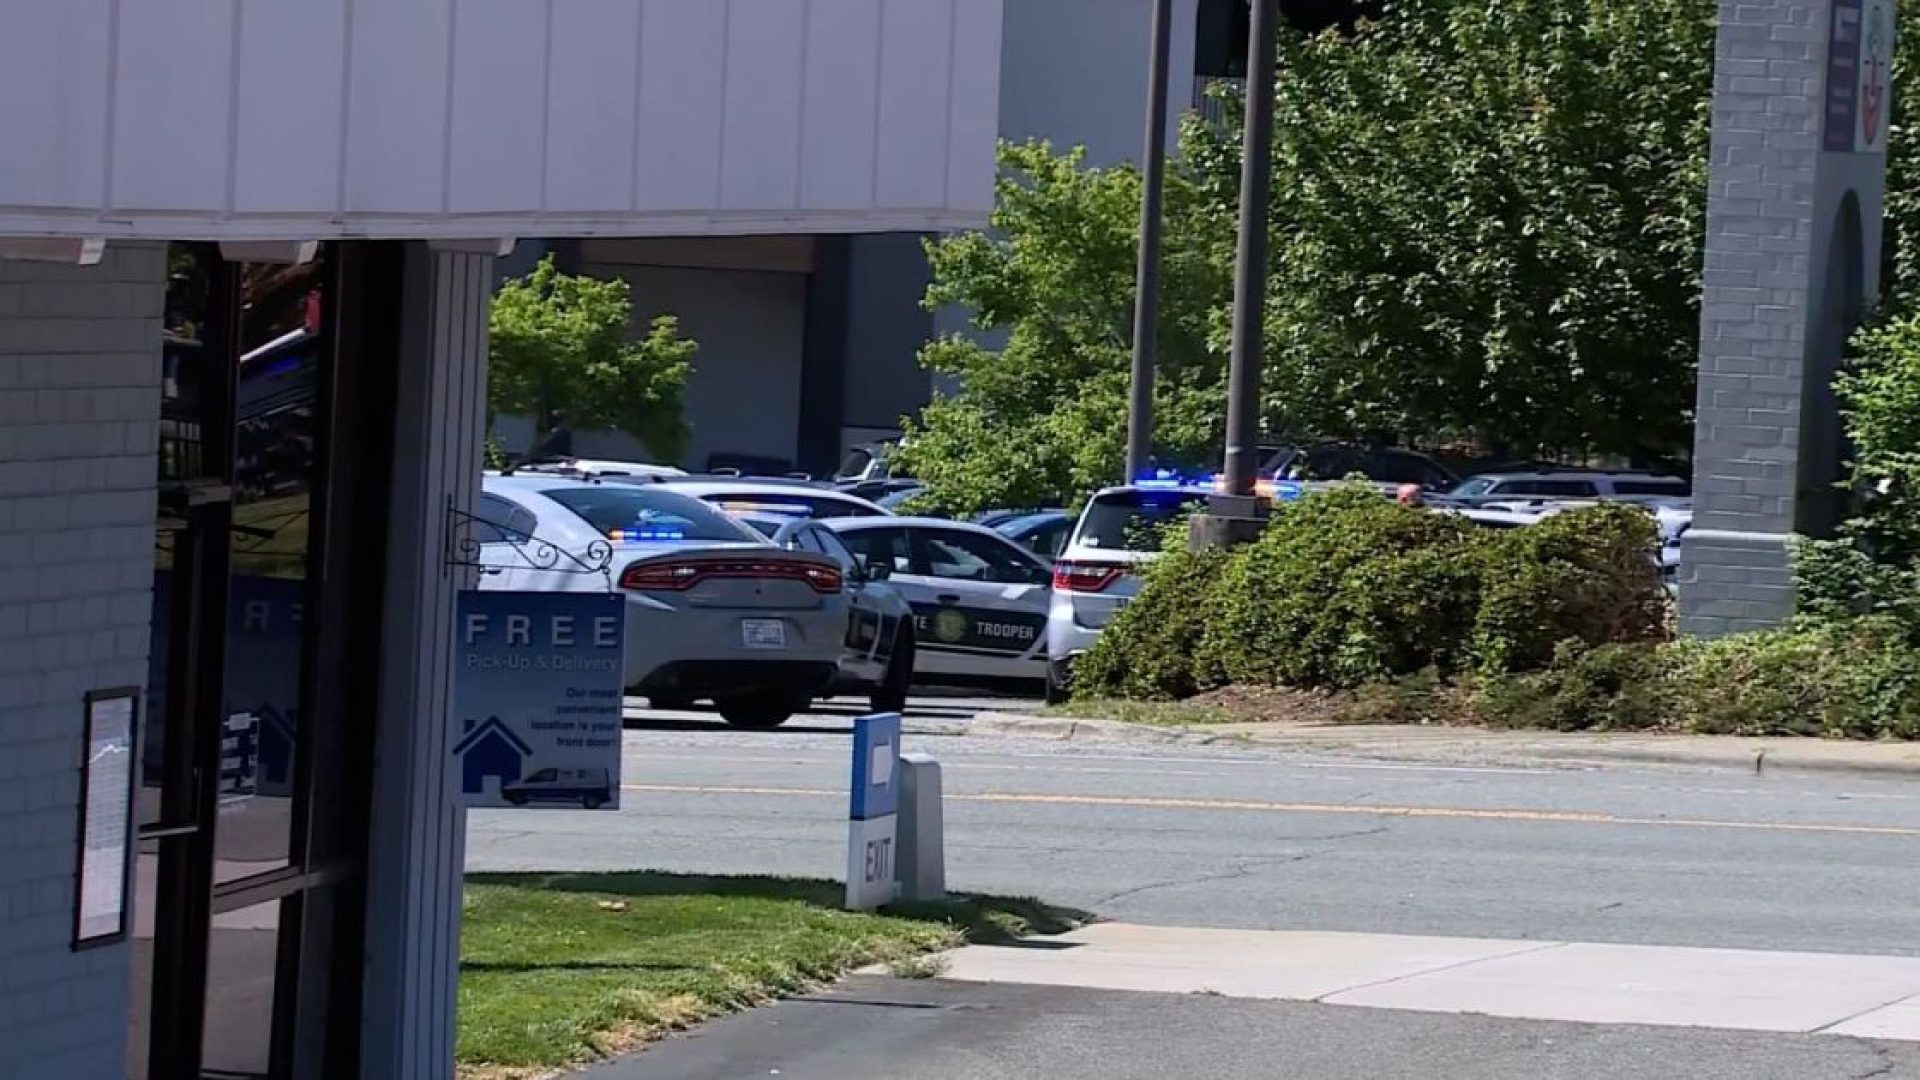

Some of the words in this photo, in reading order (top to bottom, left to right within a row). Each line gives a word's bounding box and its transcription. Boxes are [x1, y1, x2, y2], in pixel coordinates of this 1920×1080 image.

[465, 613, 617, 646] FREE
[975, 621, 1034, 639] TROOPER
[467, 654, 530, 672] Pick-Up
[535, 656, 548, 670] &
[551, 655, 617, 673] Delivery
[566, 687, 586, 698] Our
[589, 688, 618, 698] most
[556, 704, 618, 714] convenient
[531, 719, 575, 729] location
[578, 719, 587, 730] is
[591, 722, 617, 733] your
[556, 736, 584, 747] front
[865, 837, 892, 882] EXIT
